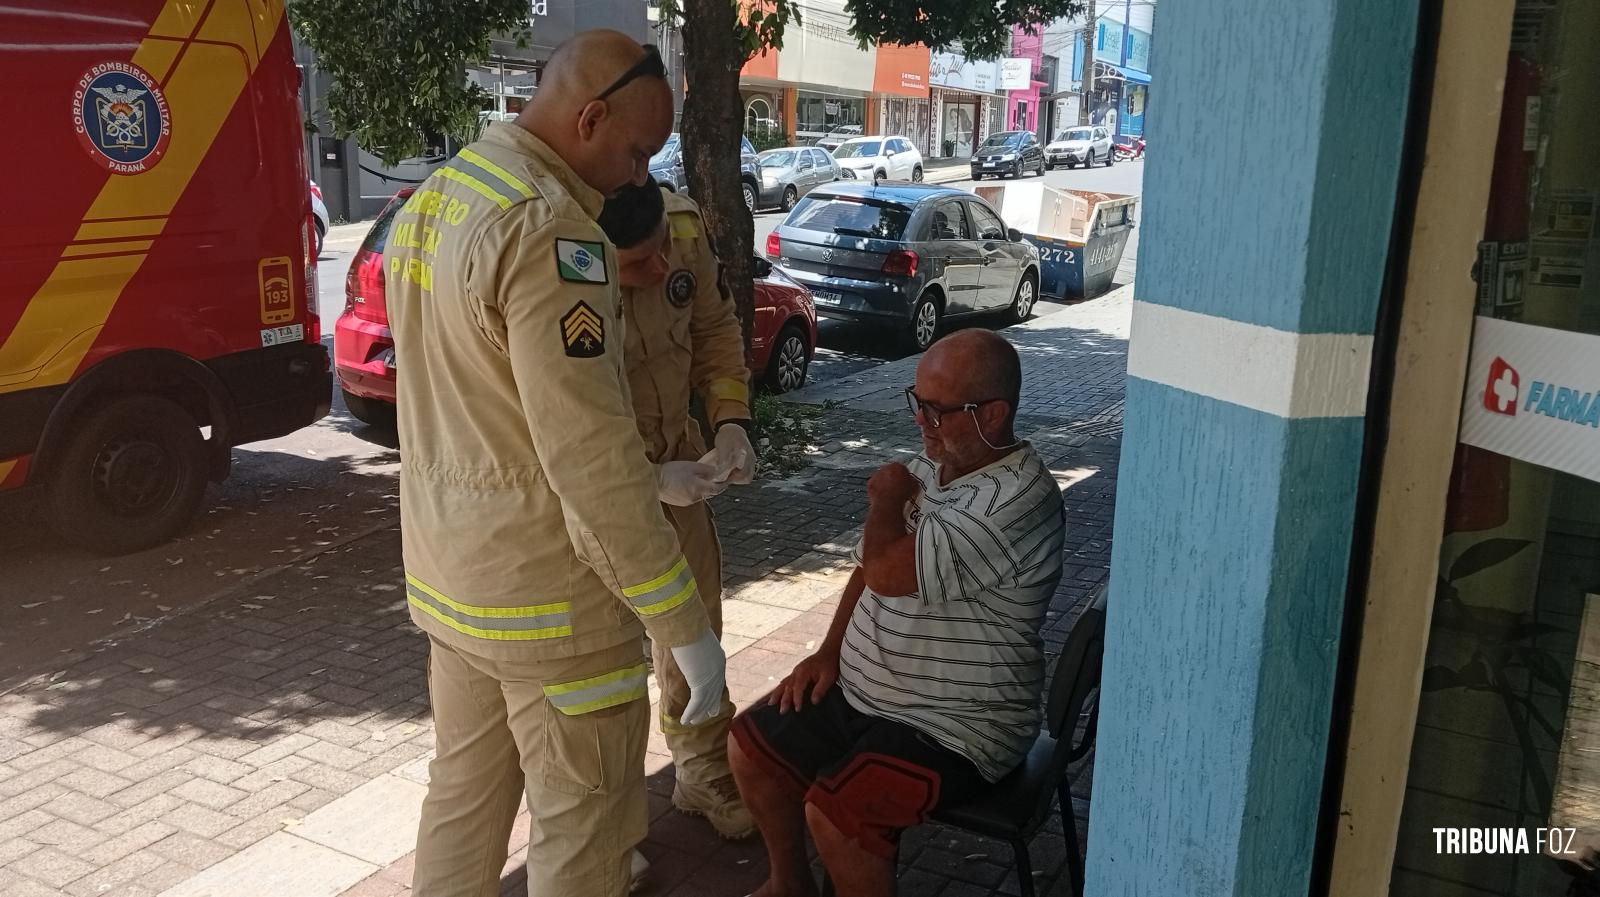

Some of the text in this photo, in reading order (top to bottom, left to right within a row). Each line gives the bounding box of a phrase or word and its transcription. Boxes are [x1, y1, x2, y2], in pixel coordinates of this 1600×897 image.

[73, 62, 170, 136] CORPO DE BOMBEIROS MILITAR
[1040, 246, 1075, 264] 272
[266, 290, 289, 305] 193
